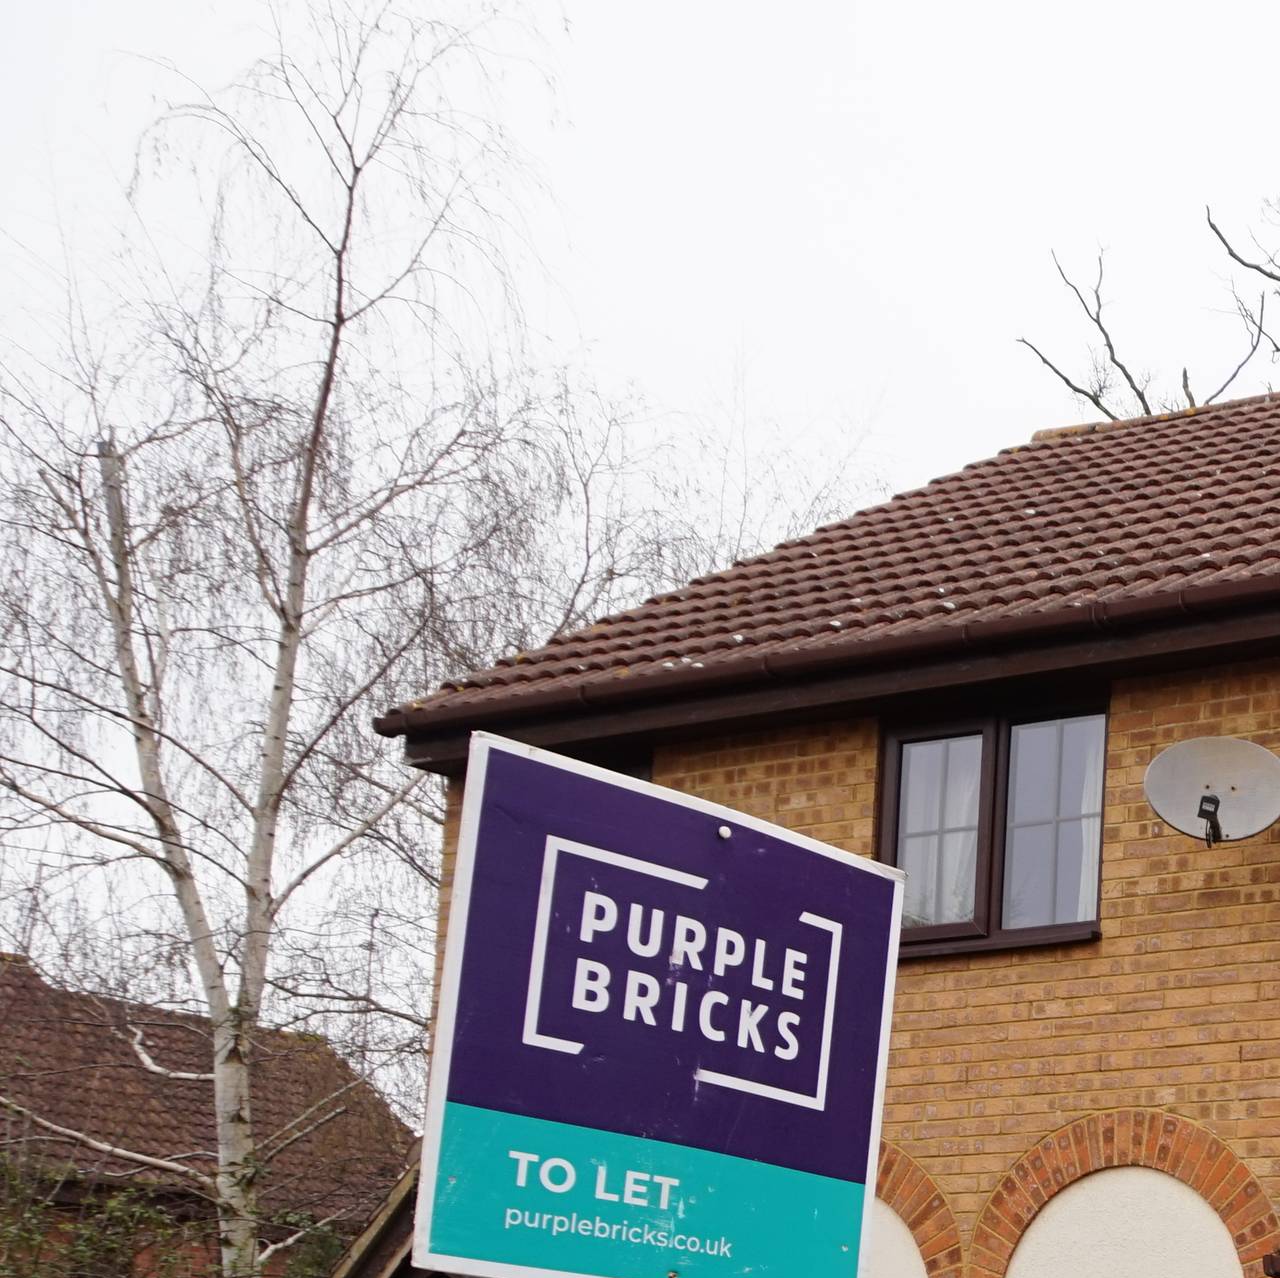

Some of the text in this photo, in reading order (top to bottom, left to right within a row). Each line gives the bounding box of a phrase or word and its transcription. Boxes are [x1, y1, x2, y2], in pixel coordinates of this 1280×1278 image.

[580, 891, 807, 1000] PURPLE
[572, 958, 800, 1060] BRICKS
[508, 1150, 680, 1210] TO LET
[504, 1207, 732, 1258] purplebricks.co.uk
